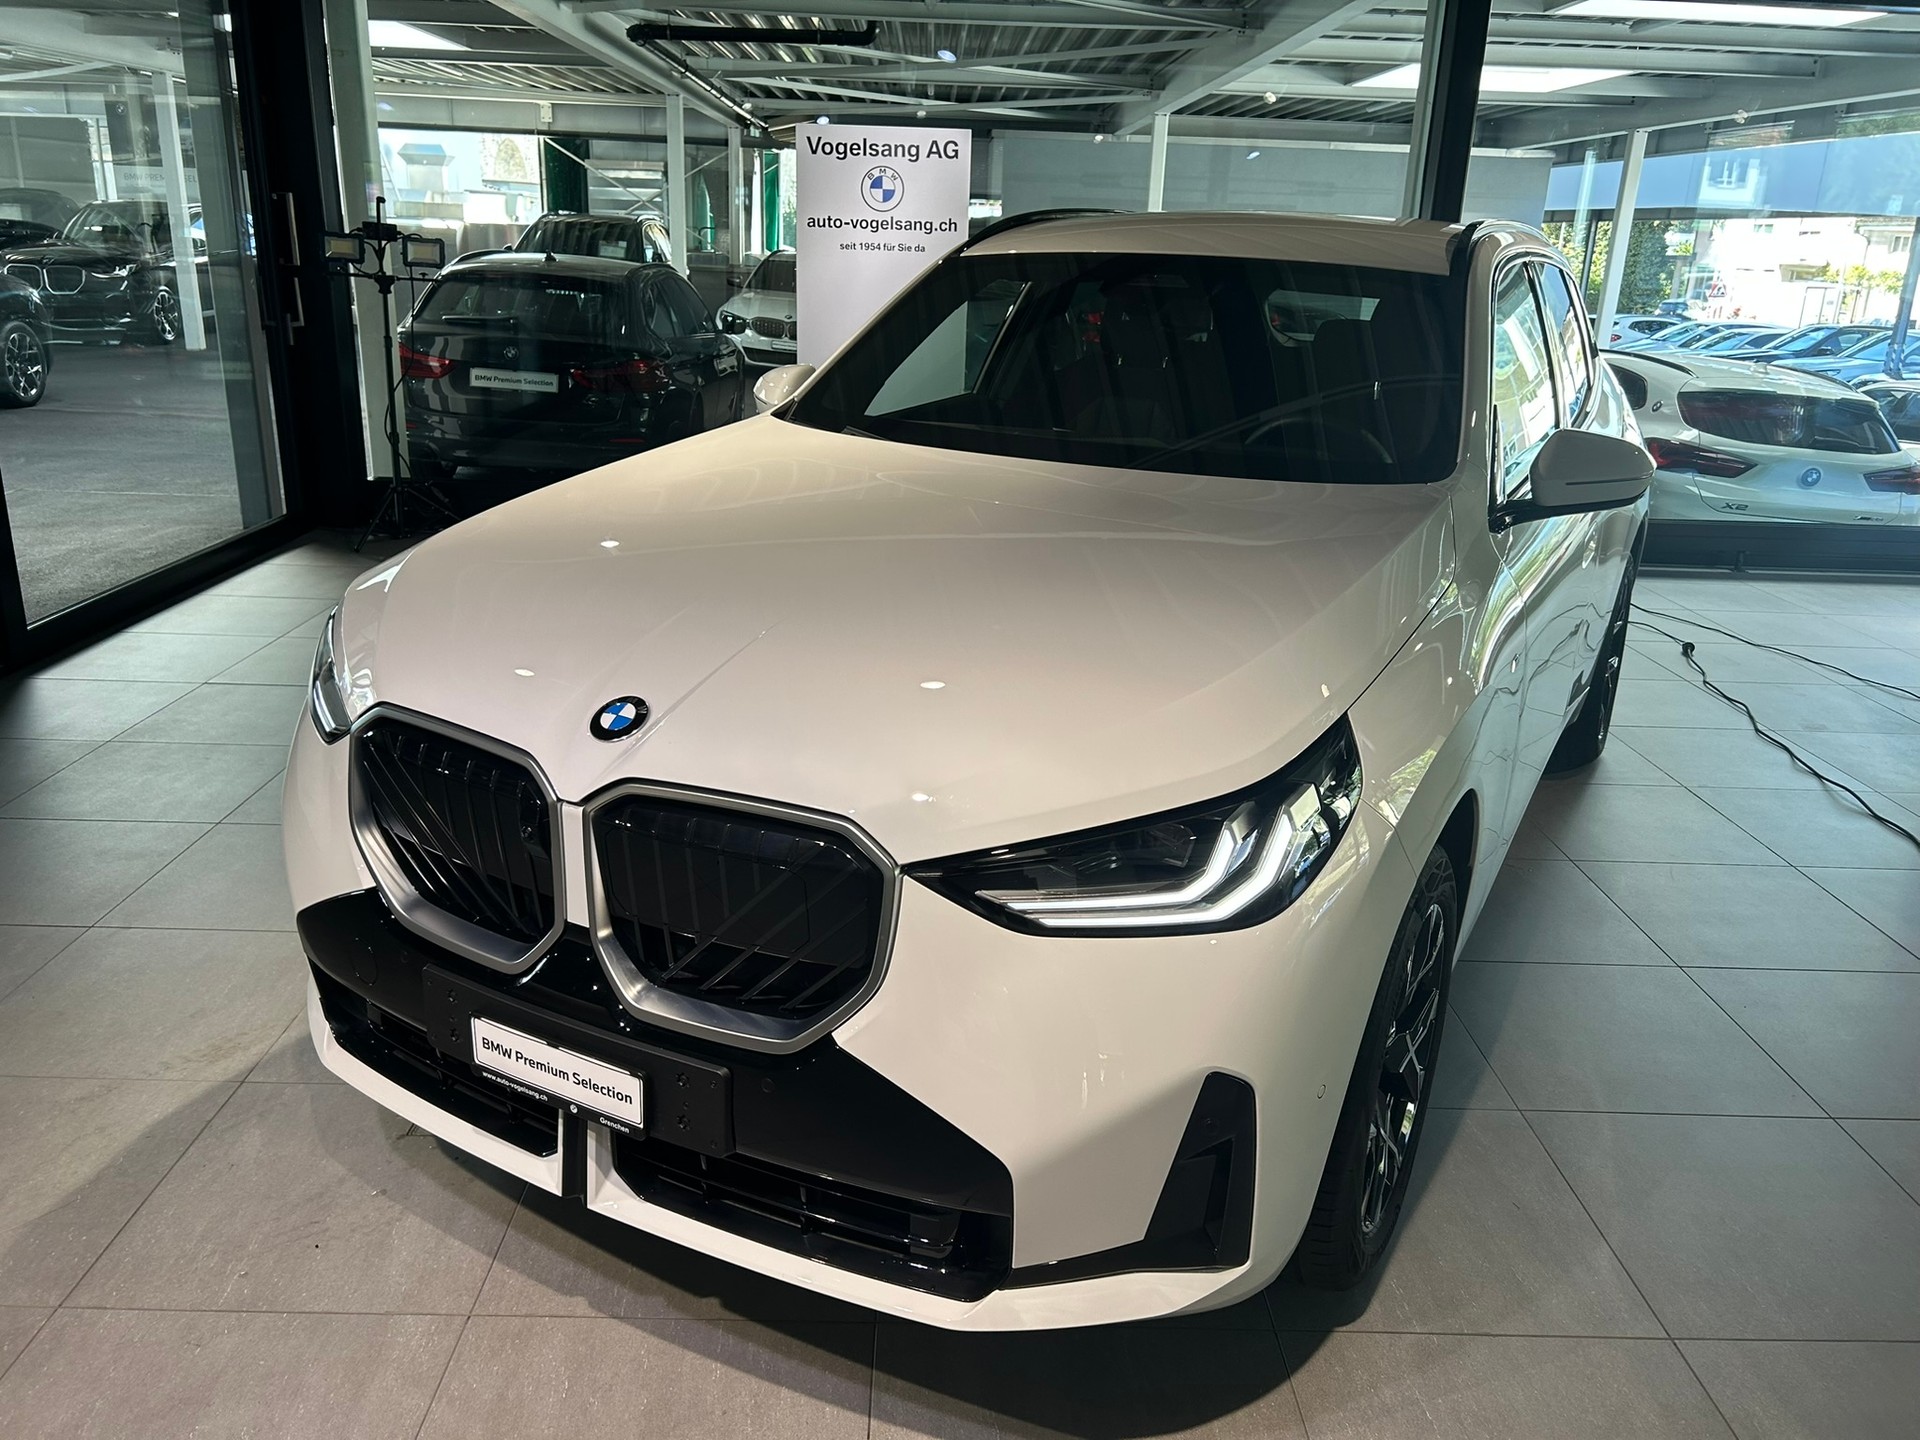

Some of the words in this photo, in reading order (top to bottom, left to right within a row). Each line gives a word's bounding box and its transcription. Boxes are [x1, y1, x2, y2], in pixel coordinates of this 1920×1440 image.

[806, 136, 920, 163] Vogelsang
[926, 139, 959, 160] AG
[866, 168, 899, 181] BMW
[806, 215, 958, 235] auto-vogelsang.ch
[839, 242, 857, 251] seit
[858, 242, 881, 251] 1954
[883, 242, 896, 252] für
[897, 243, 912, 252] Sie
[914, 243, 926, 252] da
[474, 374, 492, 382] BMW
[493, 376, 522, 384] Premium
[523, 378, 554, 386] Selection
[1720, 502, 1749, 511] X2
[482, 1036, 512, 1060] BMW
[515, 1051, 570, 1082] Premium
[573, 1072, 633, 1105] Selection
[482, 1071, 548, 1102] www.auto-vogelsang.ch
[599, 1117, 630, 1134] Grenchen
